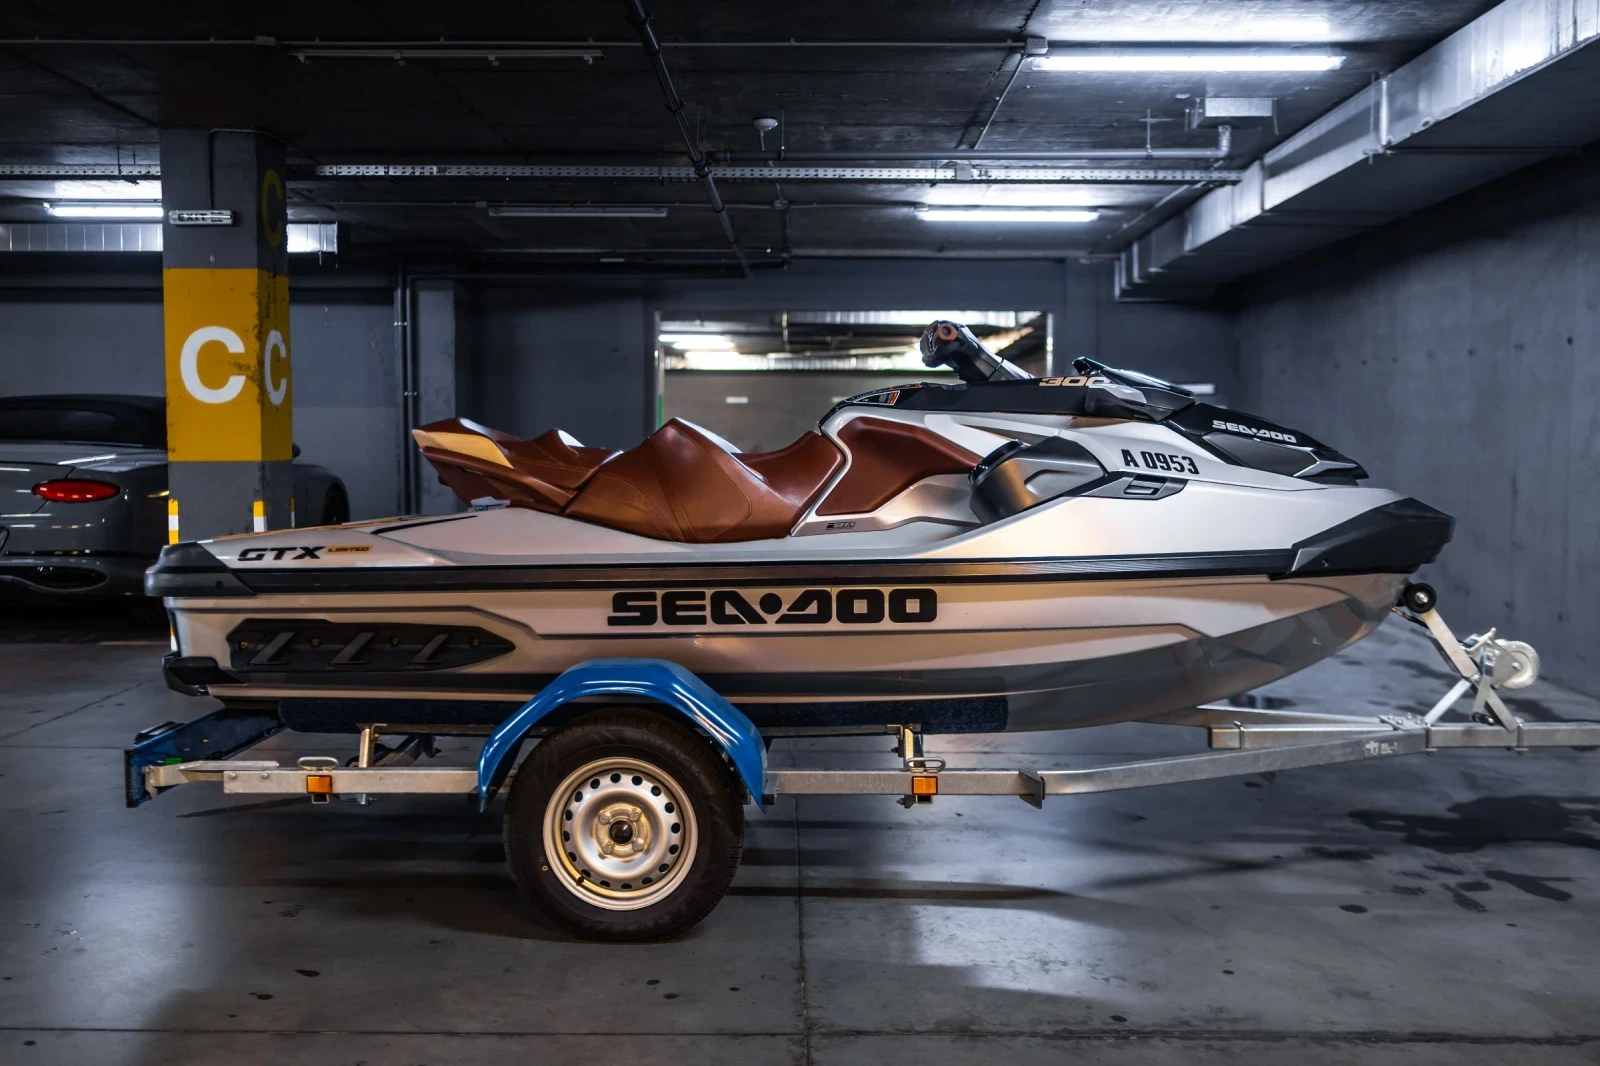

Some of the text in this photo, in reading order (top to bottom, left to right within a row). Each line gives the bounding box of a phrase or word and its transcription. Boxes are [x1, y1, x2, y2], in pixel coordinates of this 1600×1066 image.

[178, 213, 207, 222] EXIT
[262, 169, 283, 247] C
[180, 326, 246, 404] C
[264, 329, 287, 406] C
[1121, 449, 1199, 475] A 0953
[237, 546, 326, 561] GTX
